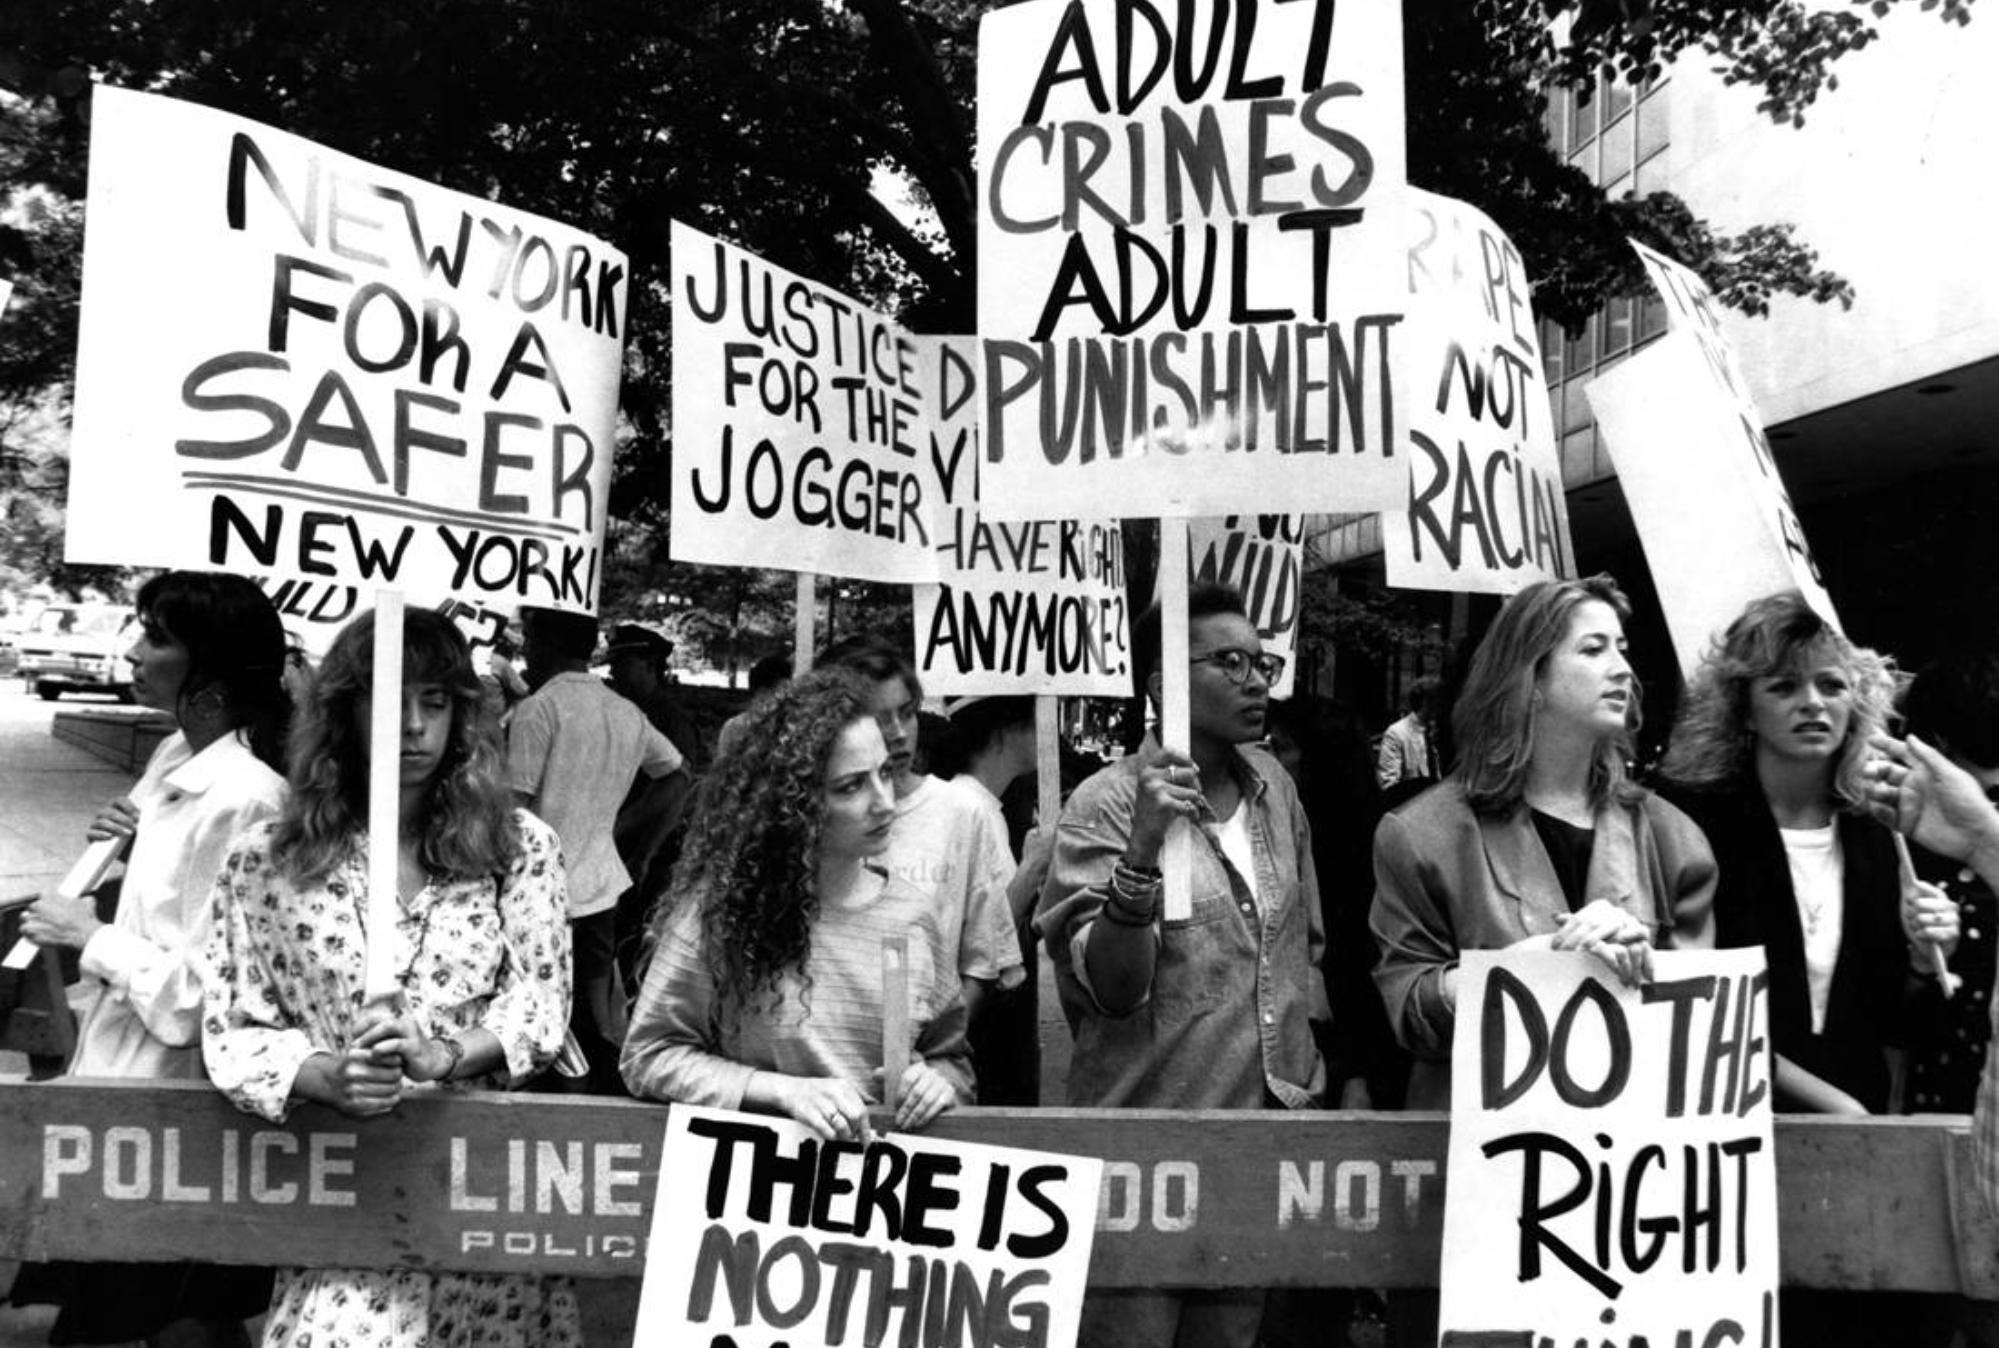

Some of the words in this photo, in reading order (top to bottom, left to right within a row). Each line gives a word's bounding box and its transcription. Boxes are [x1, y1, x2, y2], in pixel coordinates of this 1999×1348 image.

[1022, 0, 1335, 125] ADULT
[989, 81, 1374, 233] CRIMES
[226, 132, 472, 289] NEW
[481, 217, 624, 339] YORK
[1030, 208, 1364, 342] ADULT
[1408, 208, 1534, 357] RPE
[268, 253, 471, 393] FOR
[489, 321, 571, 413] A
[686, 242, 922, 400] JUSTICE
[175, 350, 593, 532] SAFER
[724, 342, 821, 433] FOR
[832, 377, 920, 457] THE
[983, 313, 1404, 465] PUNISHMENT
[1436, 341, 1534, 441] NOT
[691, 424, 929, 547] JOGGER
[936, 507, 1056, 573] HAVE
[209, 495, 414, 582] NEW
[437, 524, 597, 610] YORK!
[923, 582, 1126, 677] ANYMORE?
[1480, 966, 1632, 1111] DO
[1641, 970, 1768, 1118] THE
[42, 1125, 357, 1206] POLICE
[449, 1137, 643, 1217] LINE
[1096, 1161, 1199, 1232] DO
[1277, 1160, 1437, 1231] NOT
[687, 1117, 962, 1249] THERE
[977, 1162, 1069, 1259] IS
[461, 1231, 650, 1258] POLIC
[686, 1224, 1052, 1348] NOTHING
